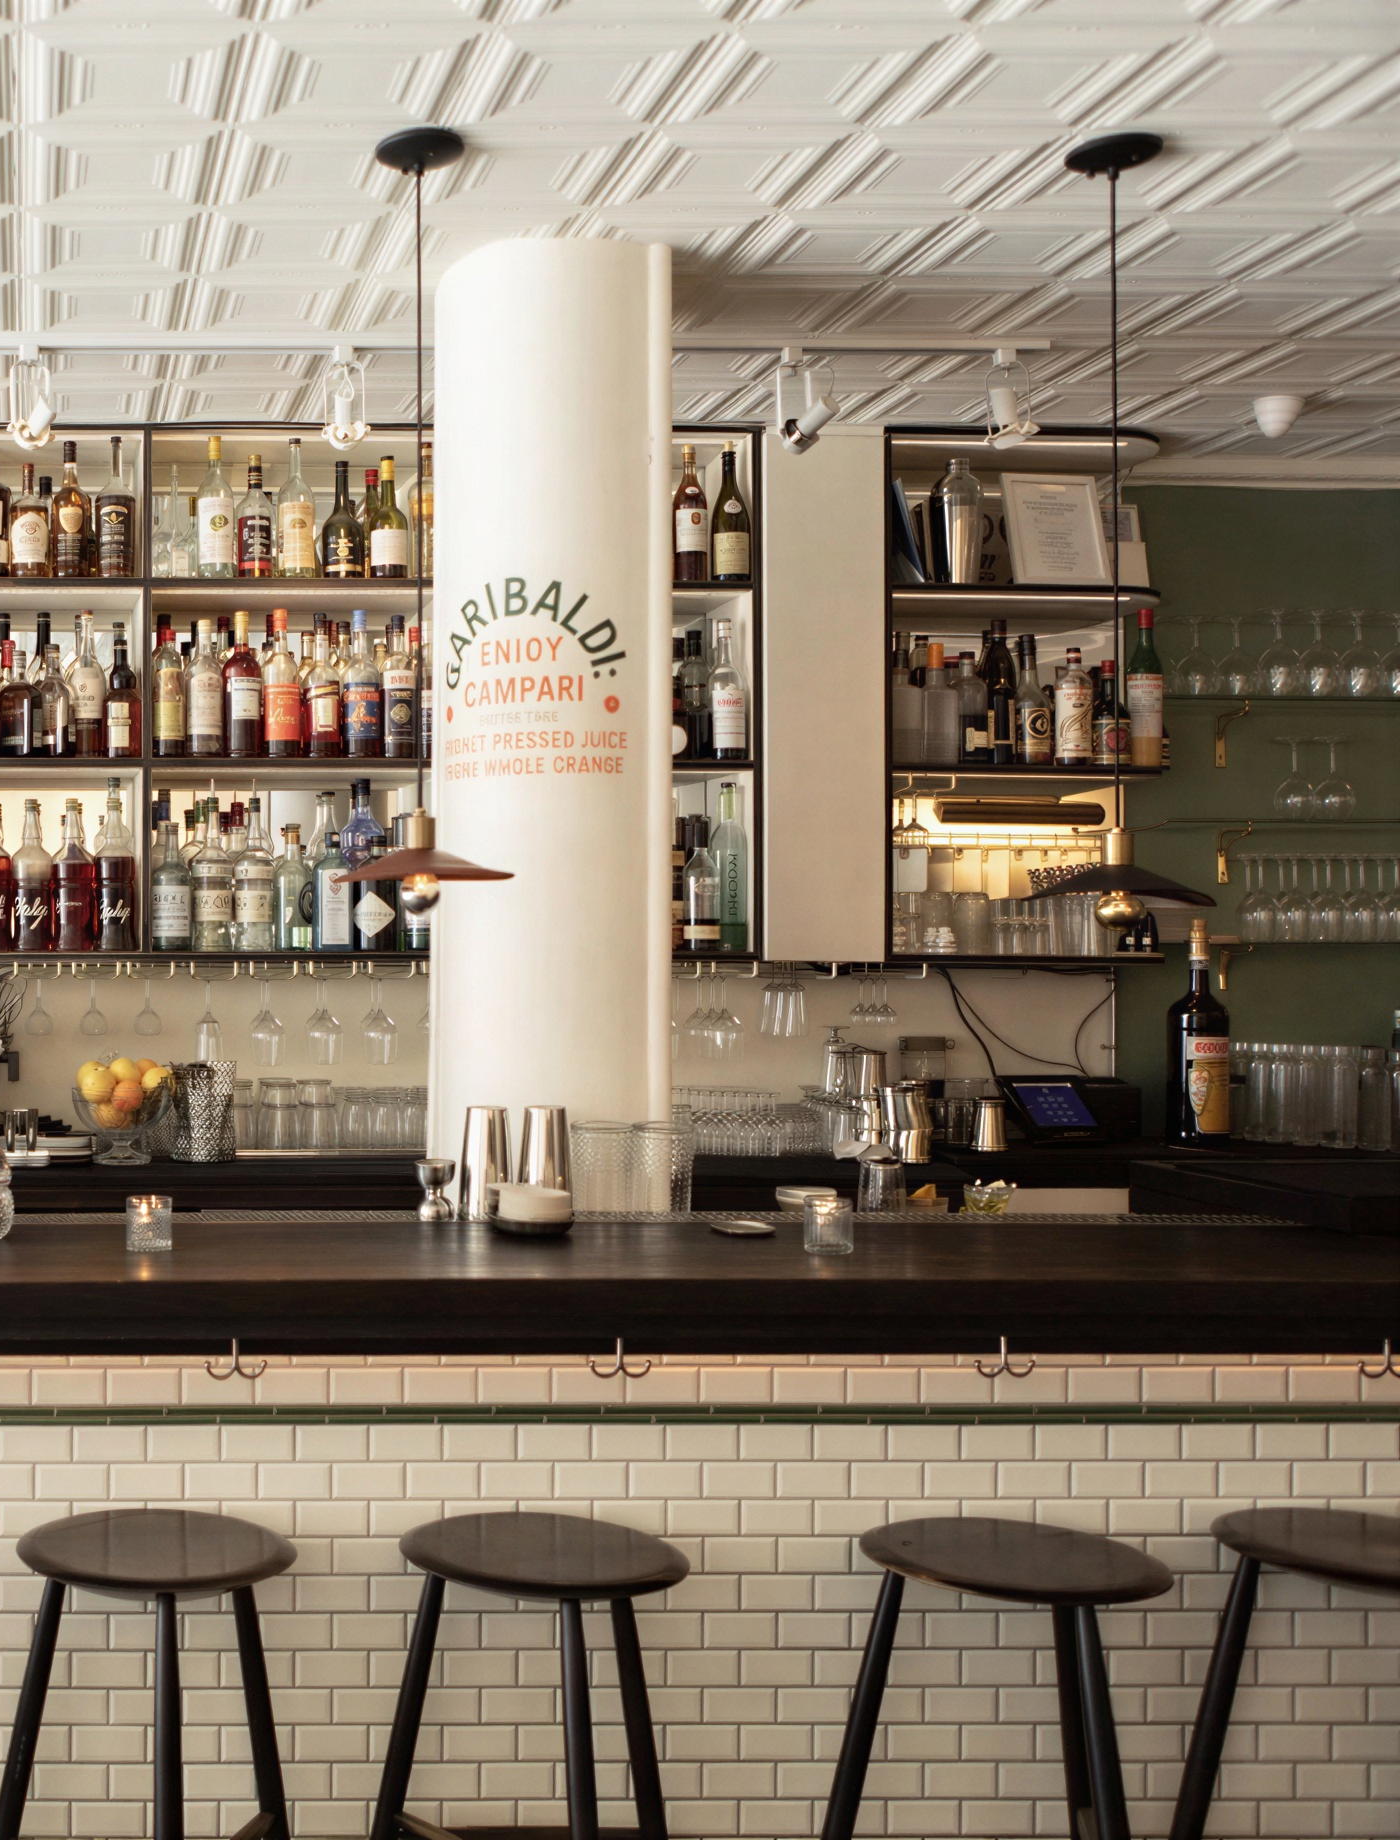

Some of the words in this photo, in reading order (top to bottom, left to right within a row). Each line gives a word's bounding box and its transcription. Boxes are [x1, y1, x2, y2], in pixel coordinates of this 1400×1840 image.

[464, 674, 584, 708] CAMPARI
[492, 731, 575, 754] PRESSED
[581, 731, 628, 750] JUICE
